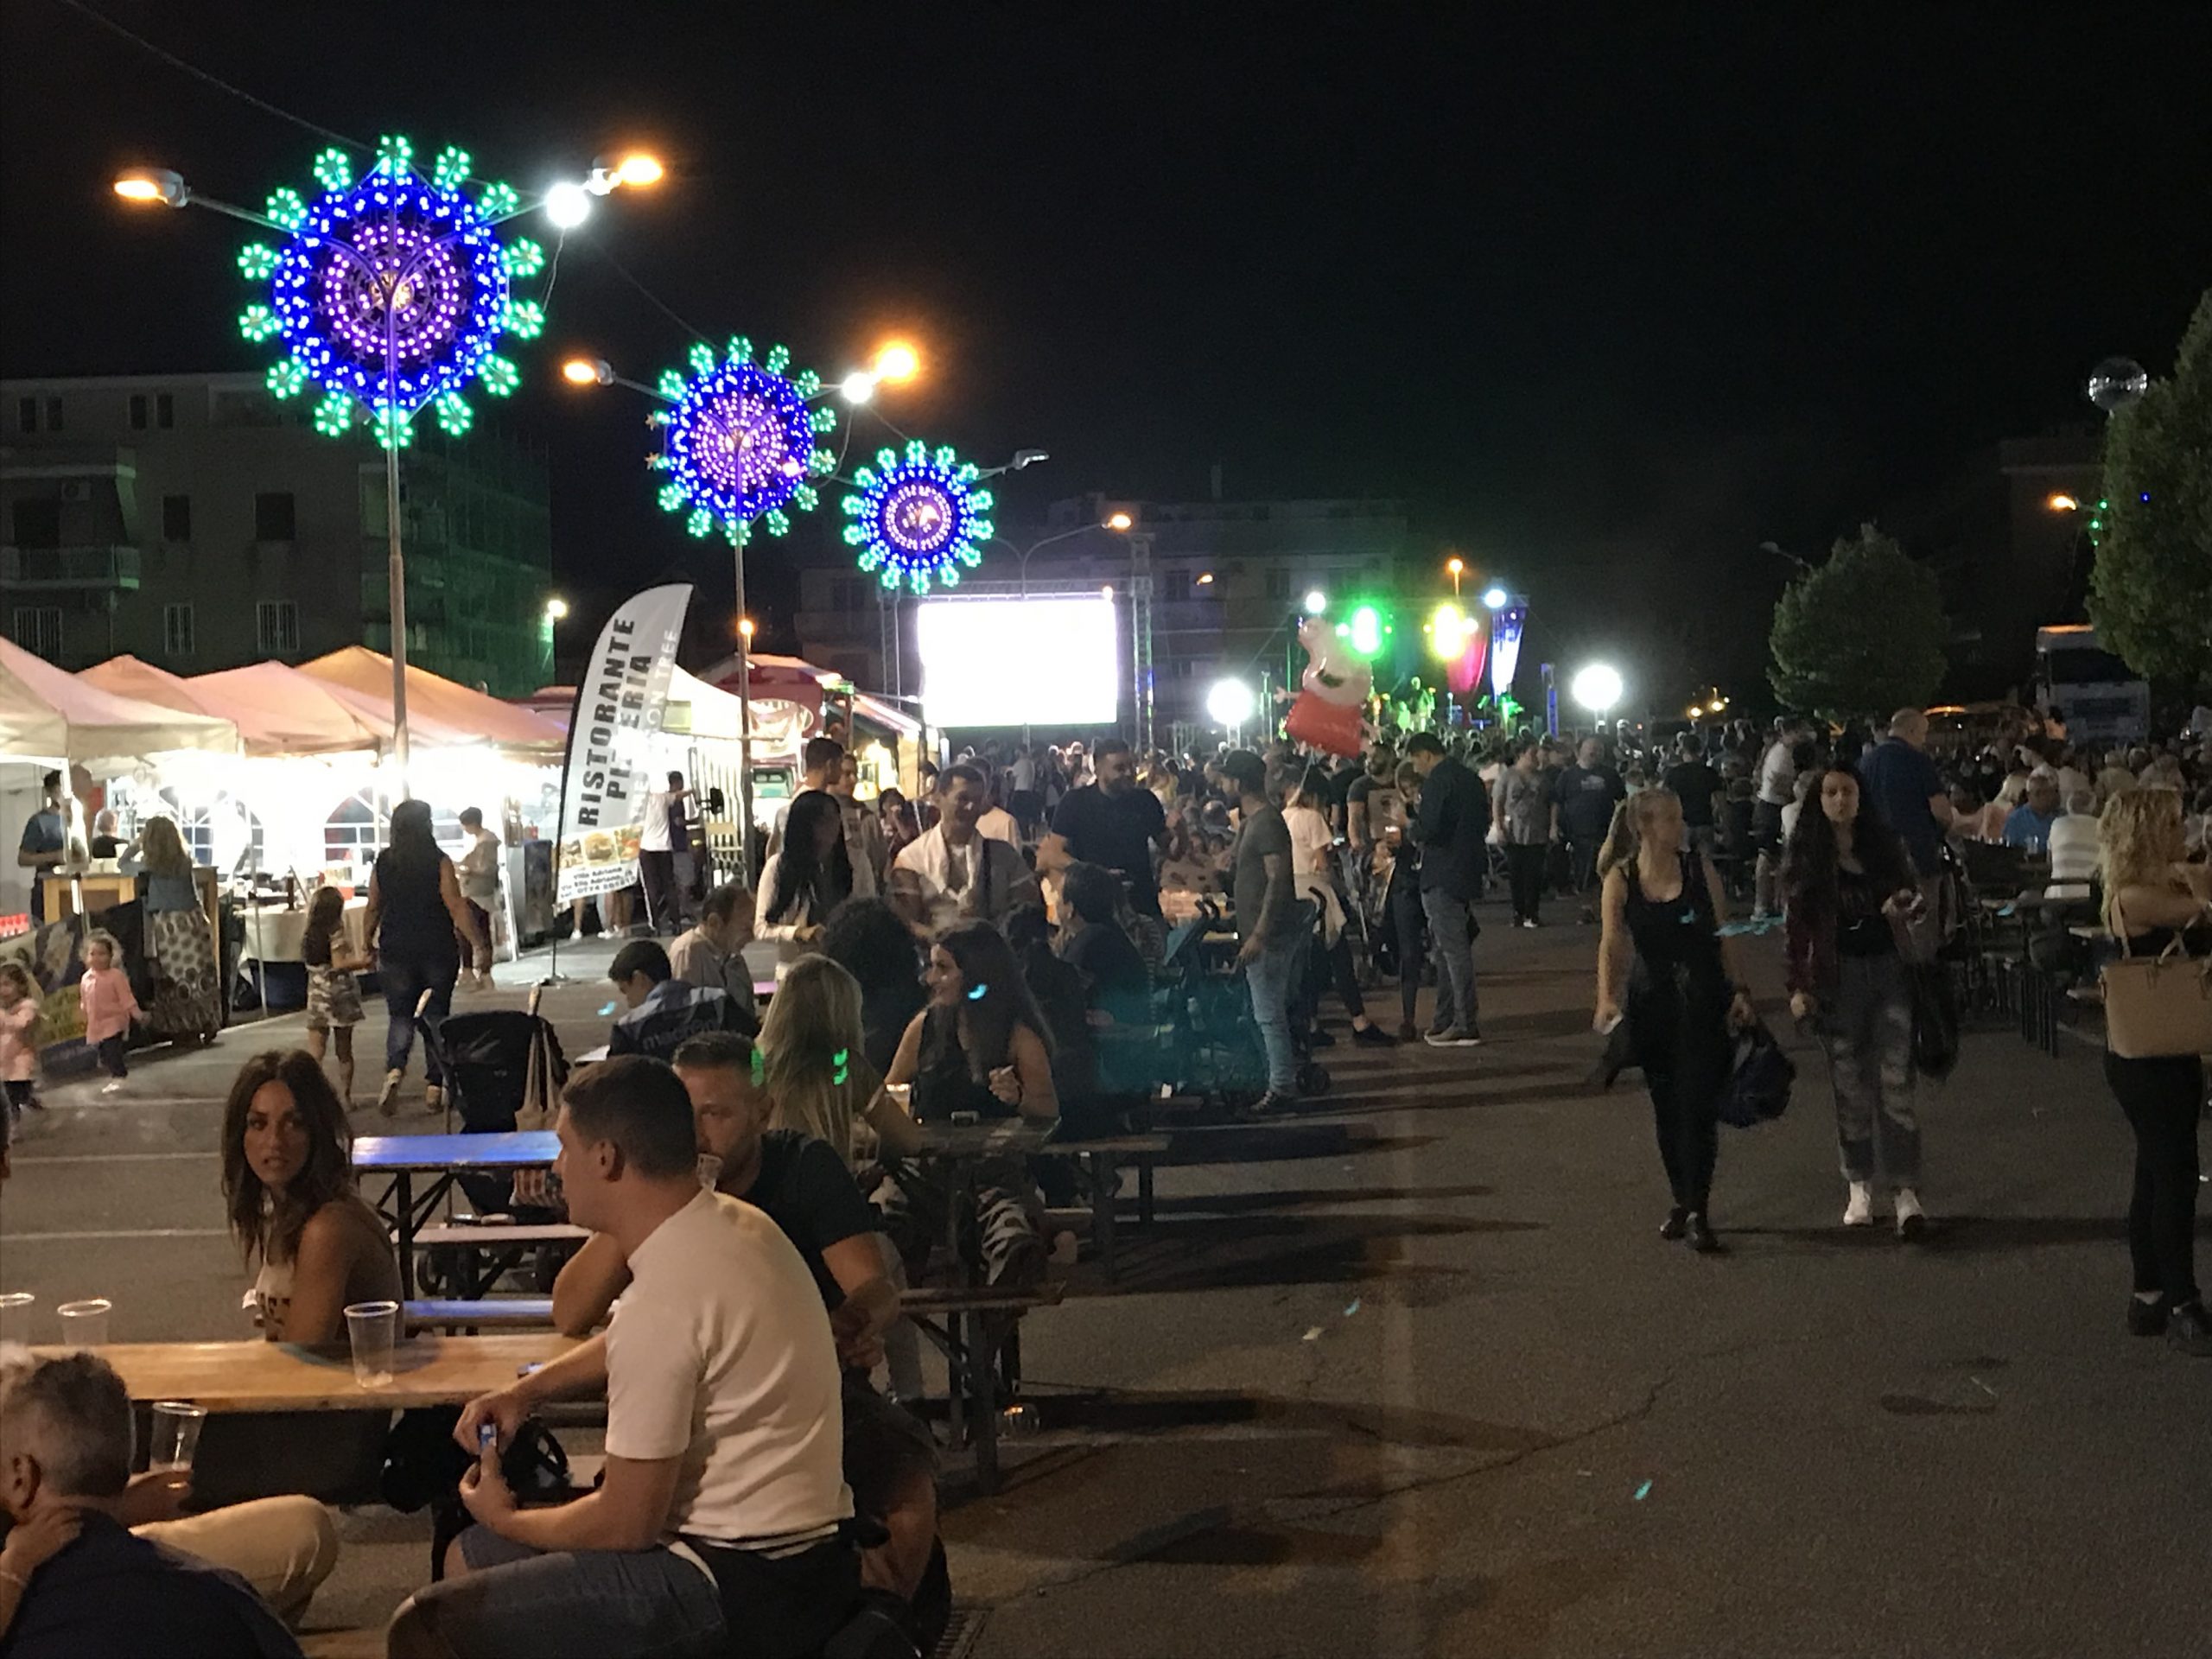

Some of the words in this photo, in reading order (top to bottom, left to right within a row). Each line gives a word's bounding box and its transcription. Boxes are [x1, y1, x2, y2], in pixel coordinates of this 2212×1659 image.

[577, 618, 635, 827] RISTORANTE
[654, 629, 679, 680] TREE
[606, 655, 652, 800] PIERIA
